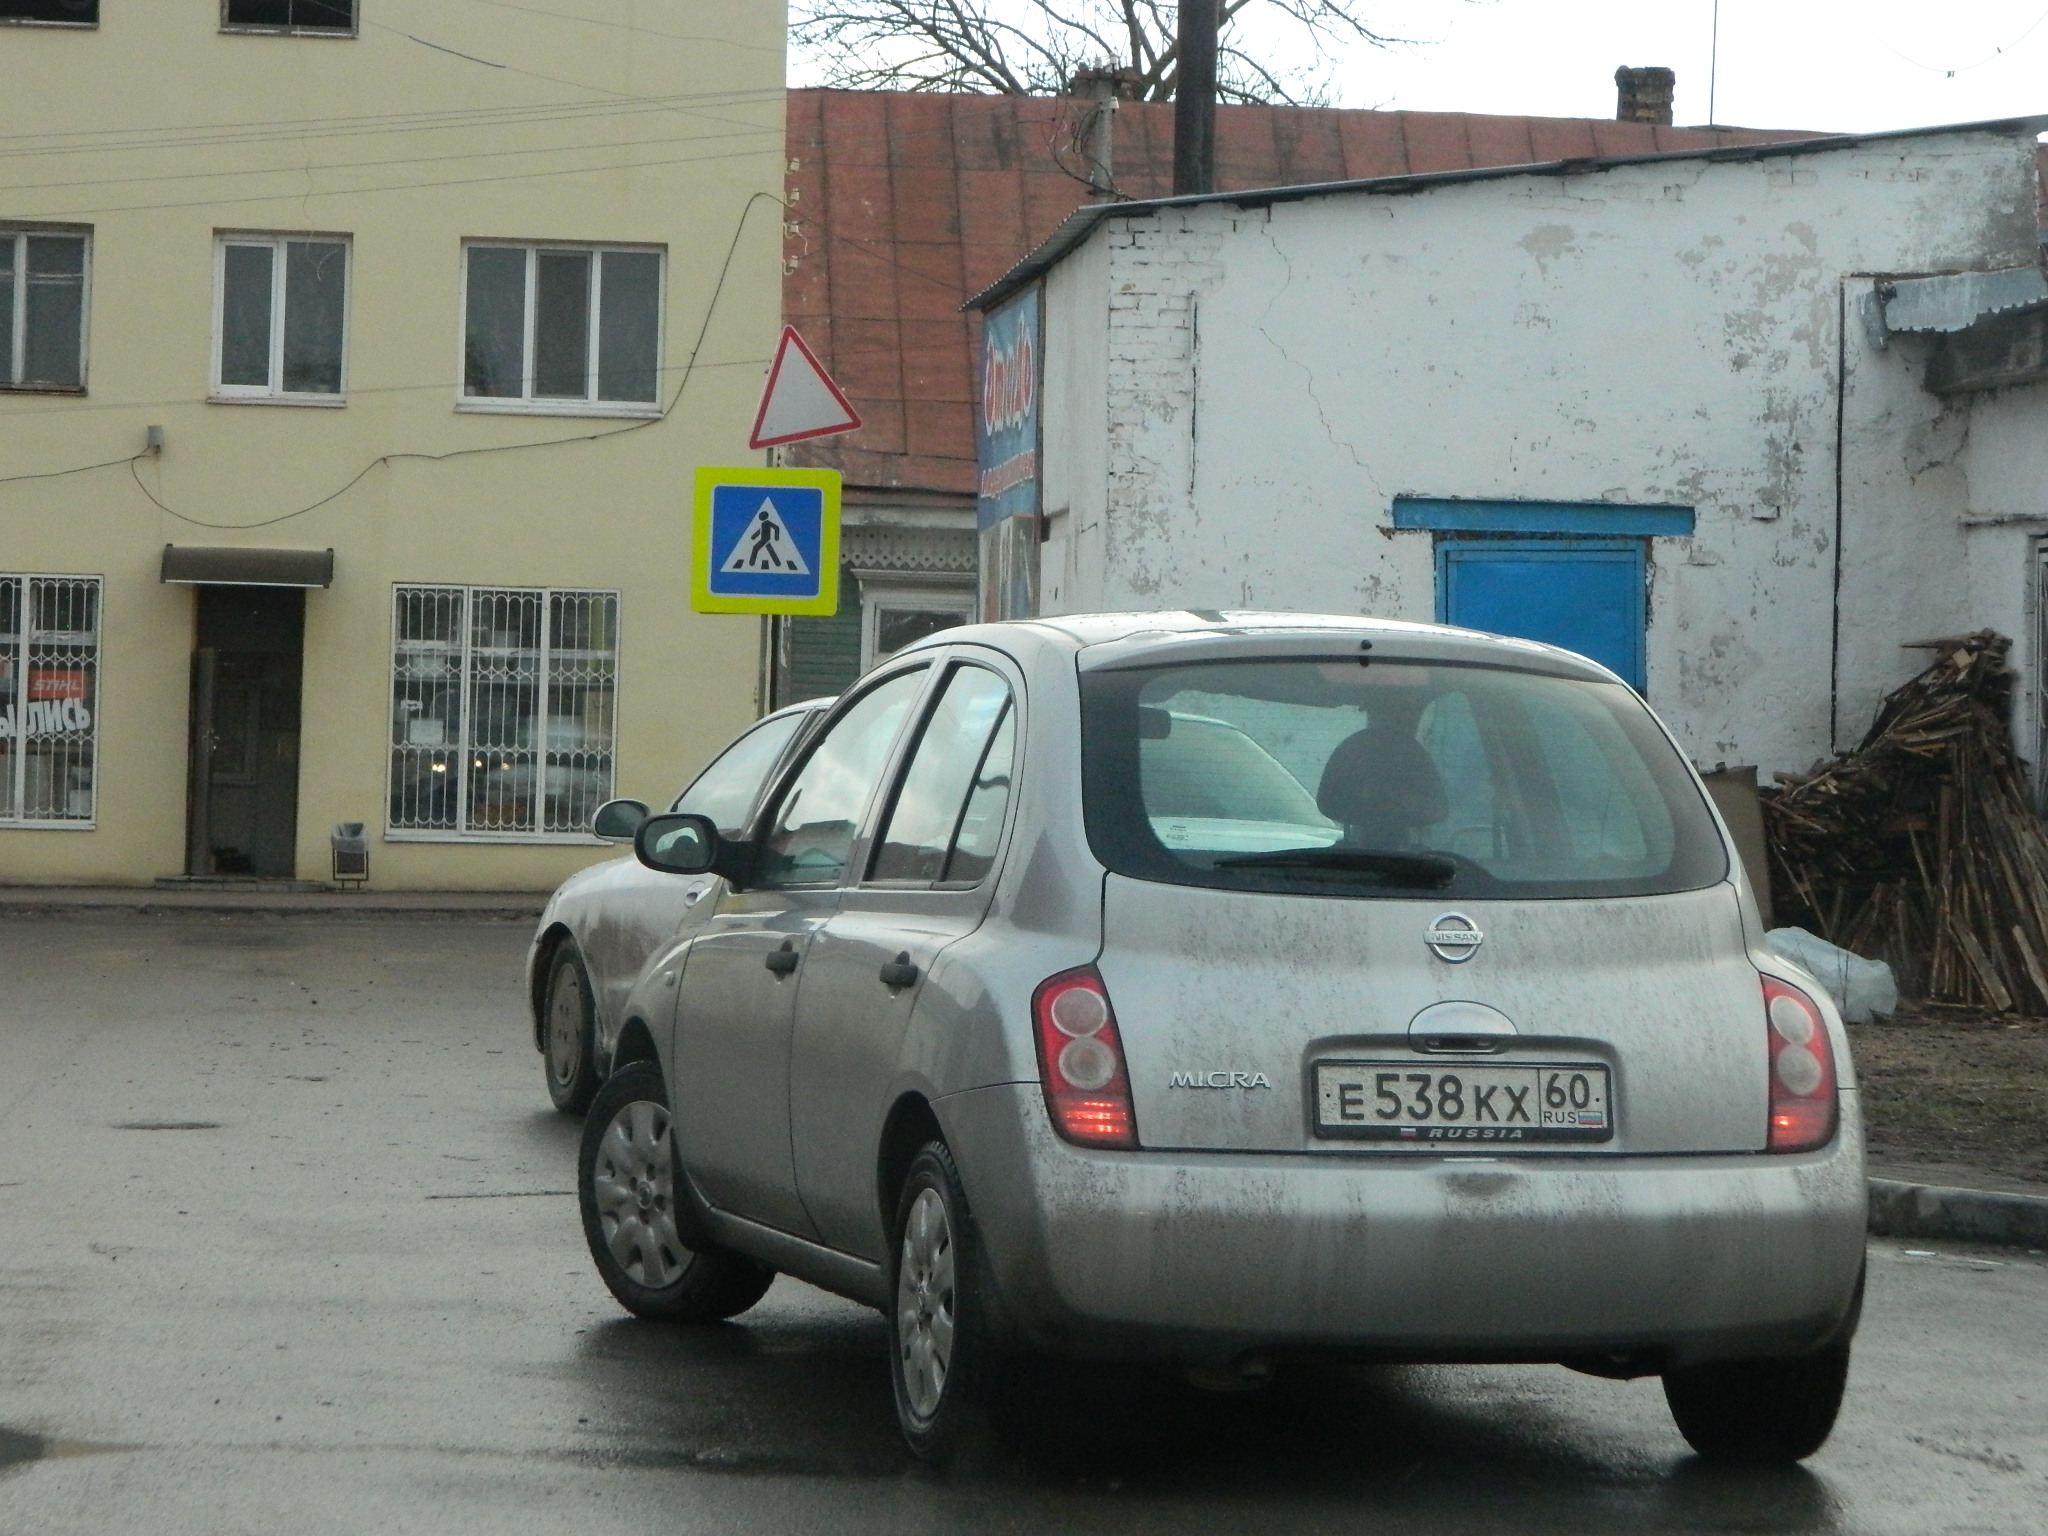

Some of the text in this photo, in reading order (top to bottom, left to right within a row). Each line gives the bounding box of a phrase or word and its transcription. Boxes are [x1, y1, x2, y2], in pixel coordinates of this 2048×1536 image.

[33, 679, 80, 690] STIHL
[1431, 932, 1479, 942] NISSAN
[1169, 1071, 1272, 1088] MICRA
[1545, 1073, 1590, 1109] 60
[1543, 1111, 1576, 1124] RUS
[1428, 1128, 1523, 1139] RUSSIA
